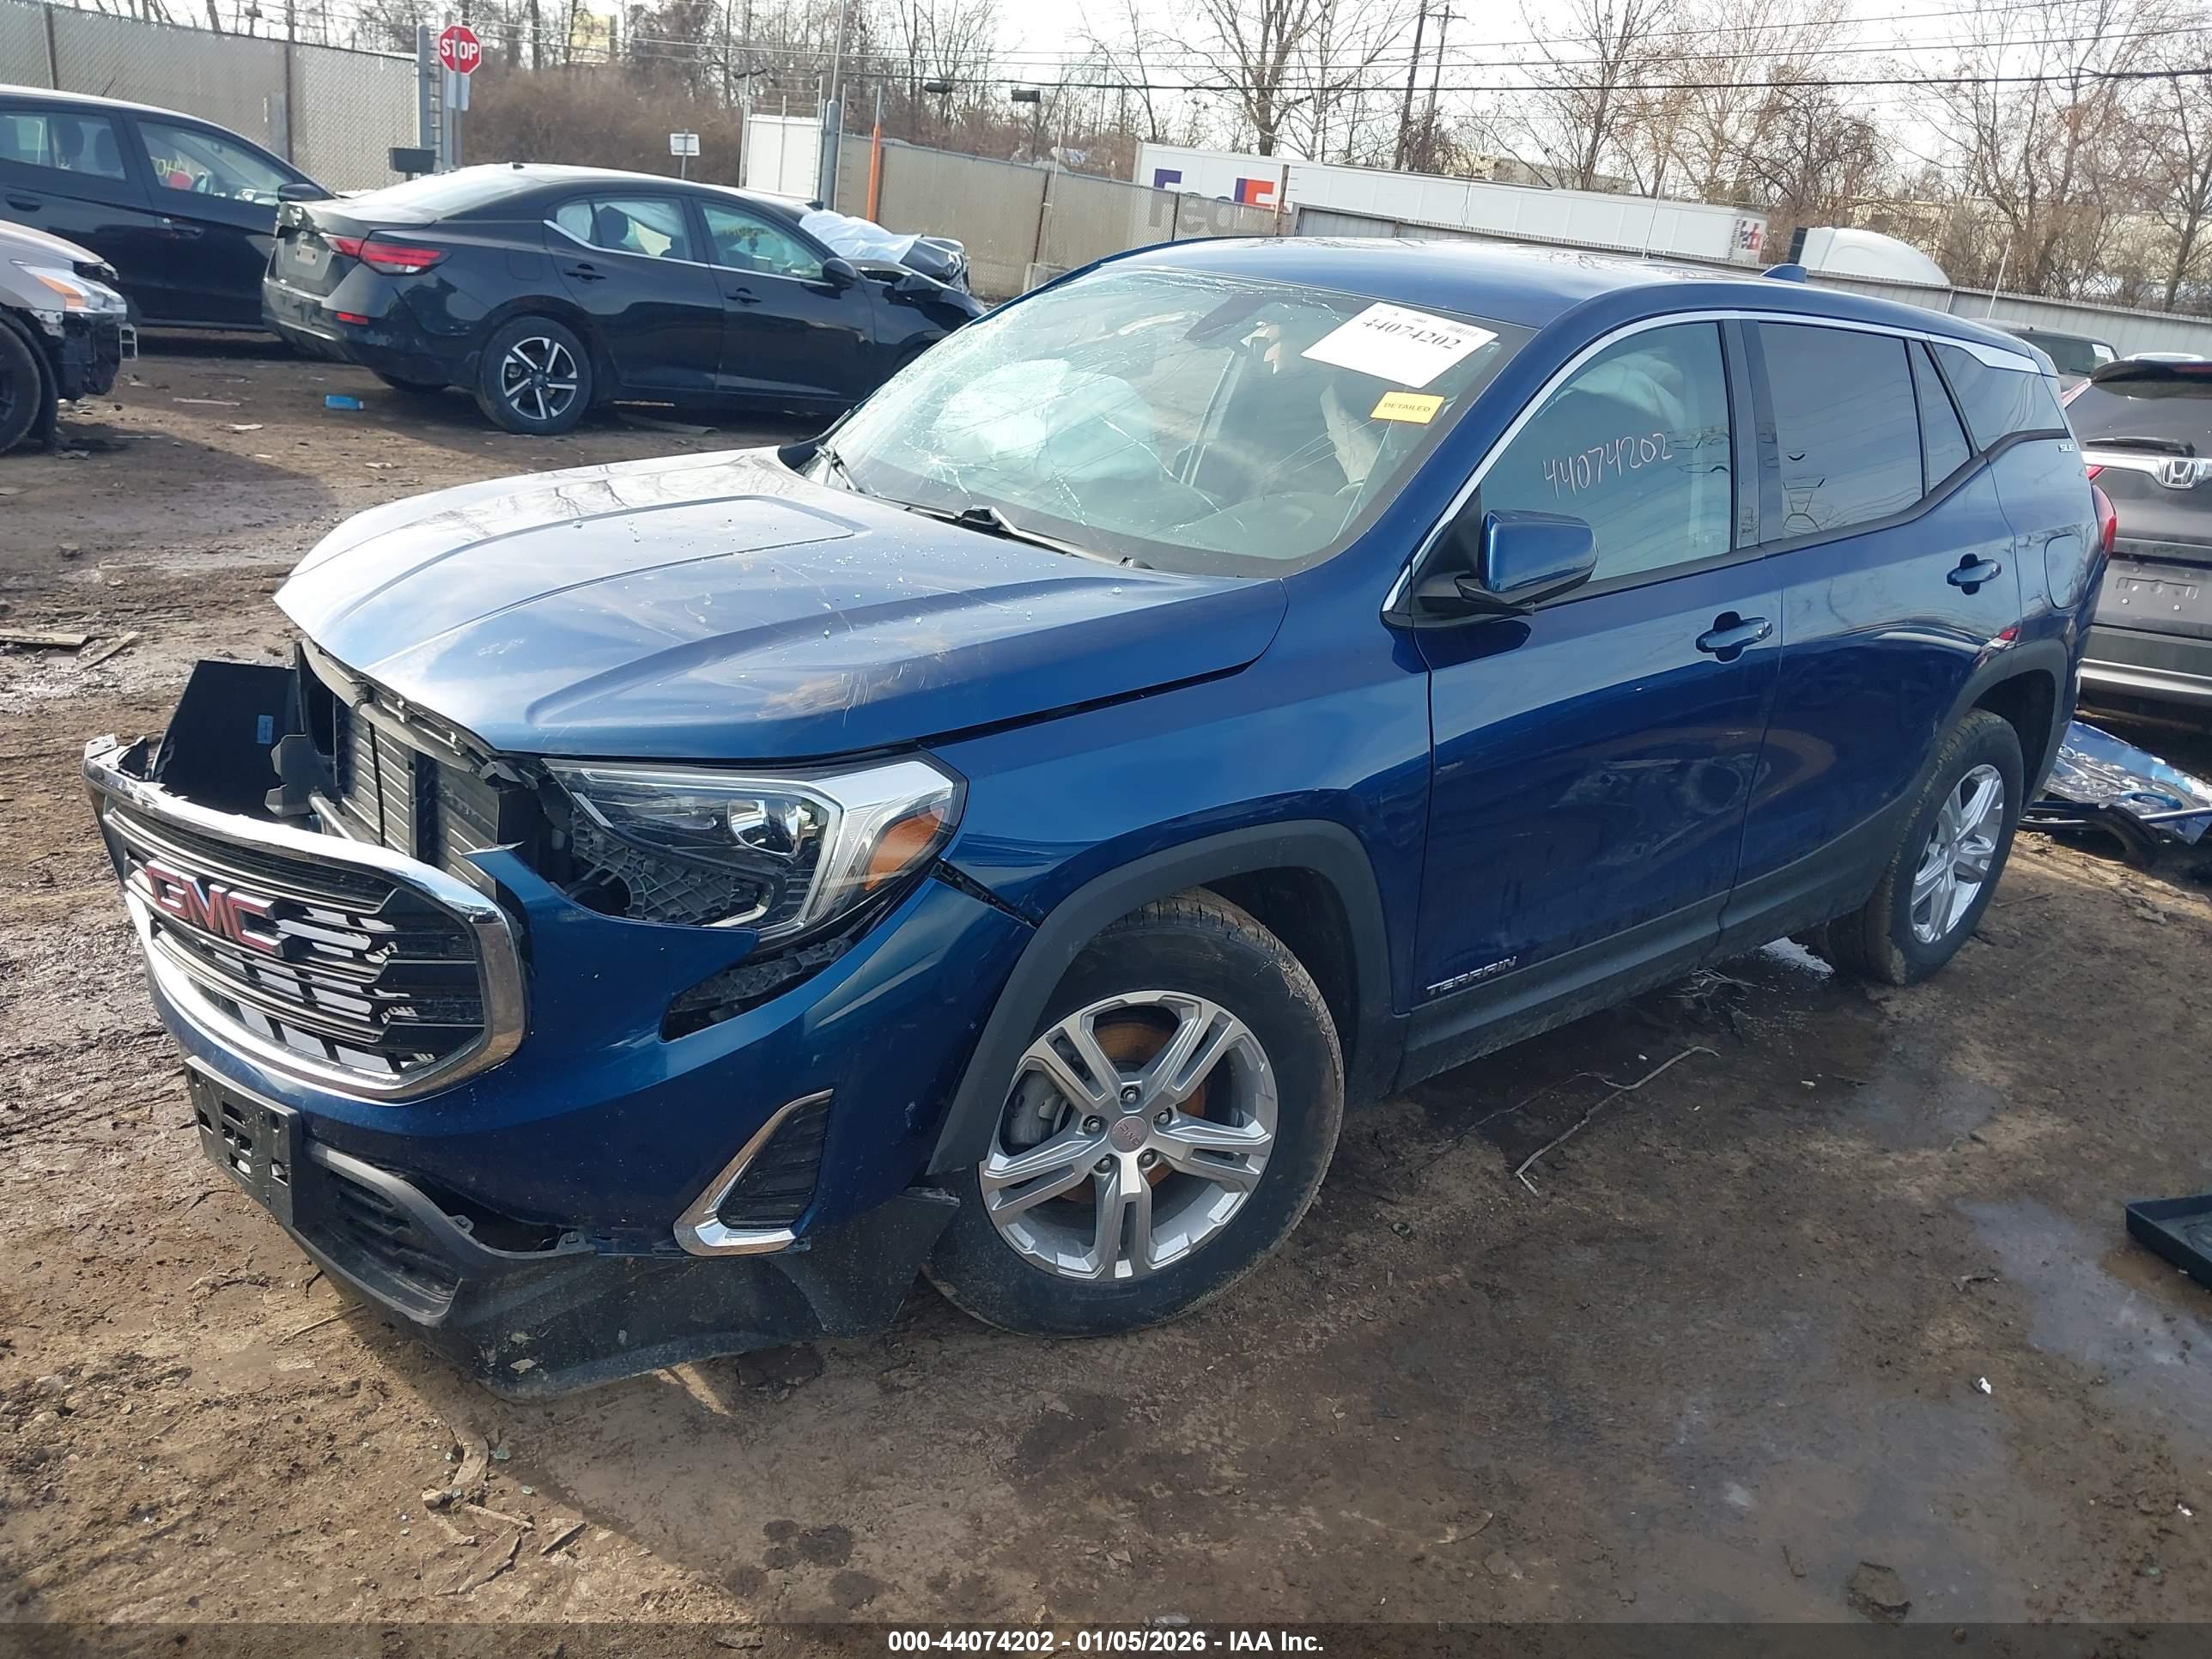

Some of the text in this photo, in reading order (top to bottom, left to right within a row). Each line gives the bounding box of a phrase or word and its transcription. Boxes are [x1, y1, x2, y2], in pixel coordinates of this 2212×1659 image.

[441, 39, 478, 61] STOP
[1362, 319, 1462, 349] 44074202
[1383, 402, 1431, 412] DETAILED
[2058, 444, 2075, 453] SLE
[1543, 433, 1673, 500] 44074202
[146, 860, 288, 957] GMC
[1426, 956, 1517, 995] TERRAIN
